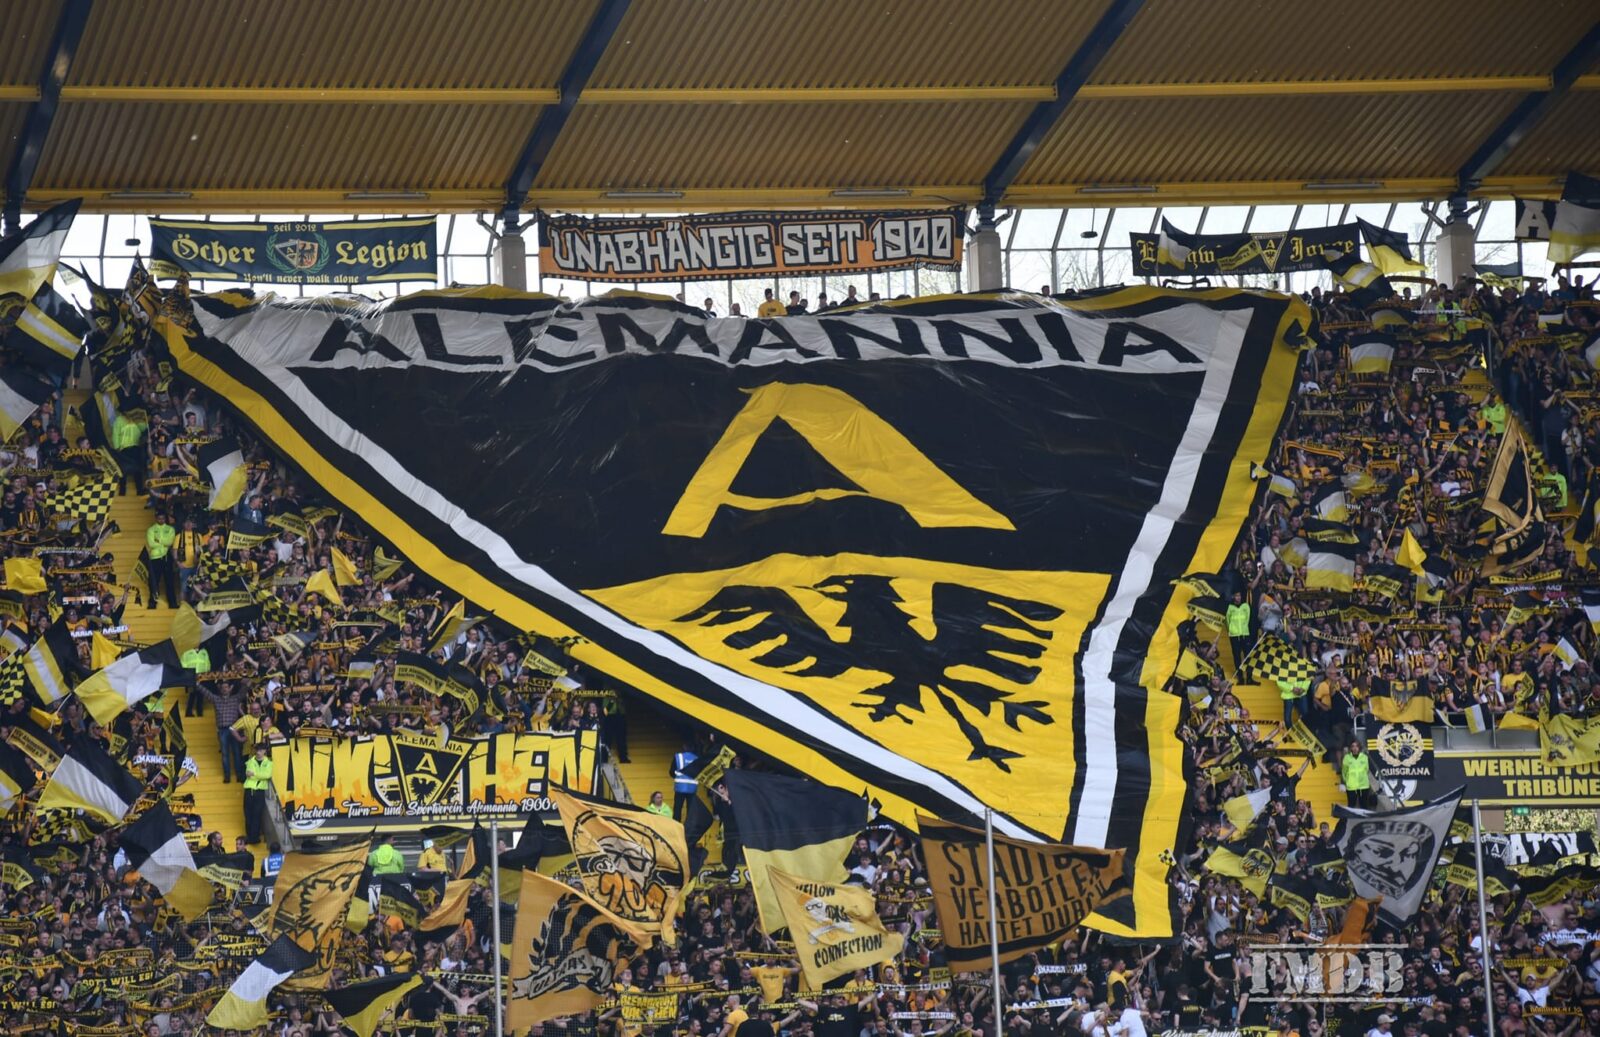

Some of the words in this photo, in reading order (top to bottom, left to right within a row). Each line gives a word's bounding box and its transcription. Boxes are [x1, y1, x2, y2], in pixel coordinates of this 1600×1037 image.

[295, 223, 318, 233] 2012
[172, 233, 256, 267] Öcher
[336, 239, 427, 269] Legion
[551, 221, 774, 271] UNABHÄNGIG
[782, 222, 862, 265] SEIT
[872, 217, 952, 261] 1900
[307, 274, 329, 283] walk
[334, 274, 360, 284] alone
[309, 308, 1204, 373] ALEMANNIA
[661, 382, 1016, 538] A
[397, 734, 463, 753] ALEMANIA
[415, 752, 437, 775] A
[1503, 776, 1600, 797] TRIBÜNE
[294, 805, 339, 819] Aachener
[342, 801, 378, 819] Turn-
[383, 804, 403, 816] und
[466, 799, 518, 814] Alemannia
[520, 798, 550, 813] 1900
[814, 934, 883, 968] CONNECTION
[110, 975, 136, 986] WILL
